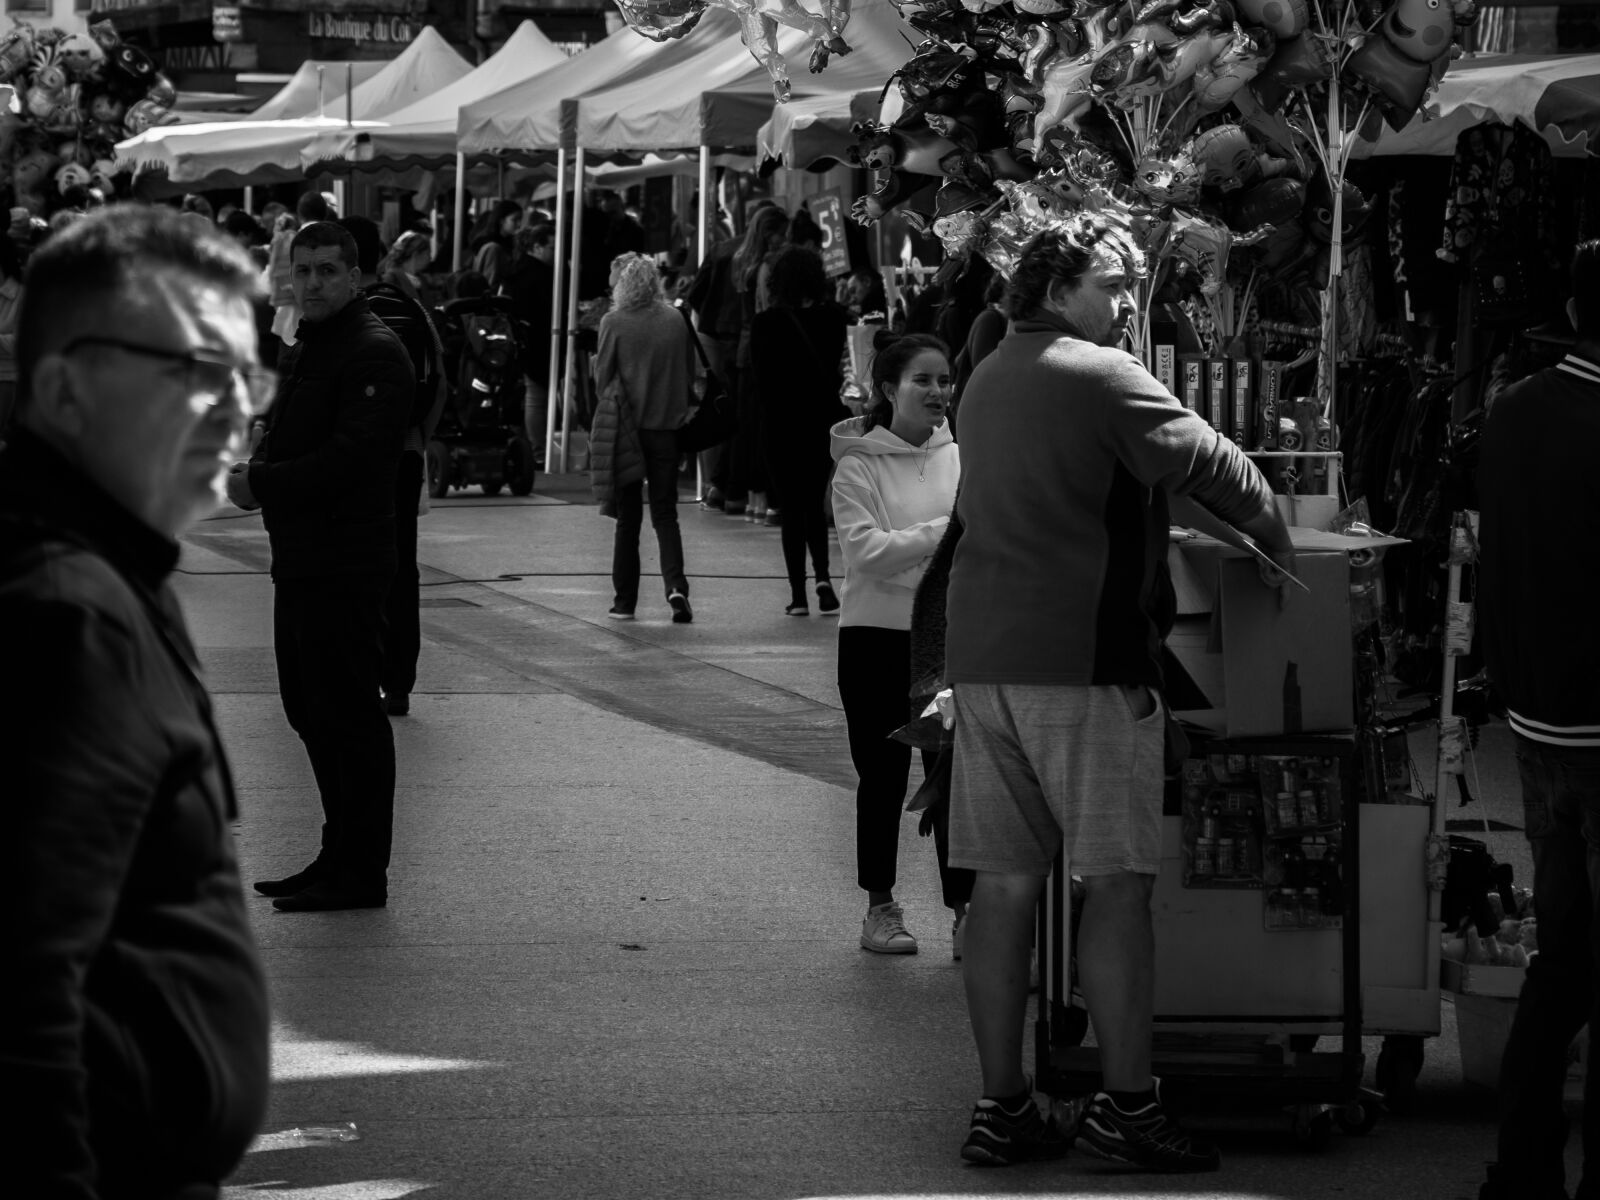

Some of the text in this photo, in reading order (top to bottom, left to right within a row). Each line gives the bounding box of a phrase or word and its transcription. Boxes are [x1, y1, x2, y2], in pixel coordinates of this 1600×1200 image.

[308, 11, 322, 37] La
[324, 12, 371, 47] Boutique
[374, 13, 389, 41] du
